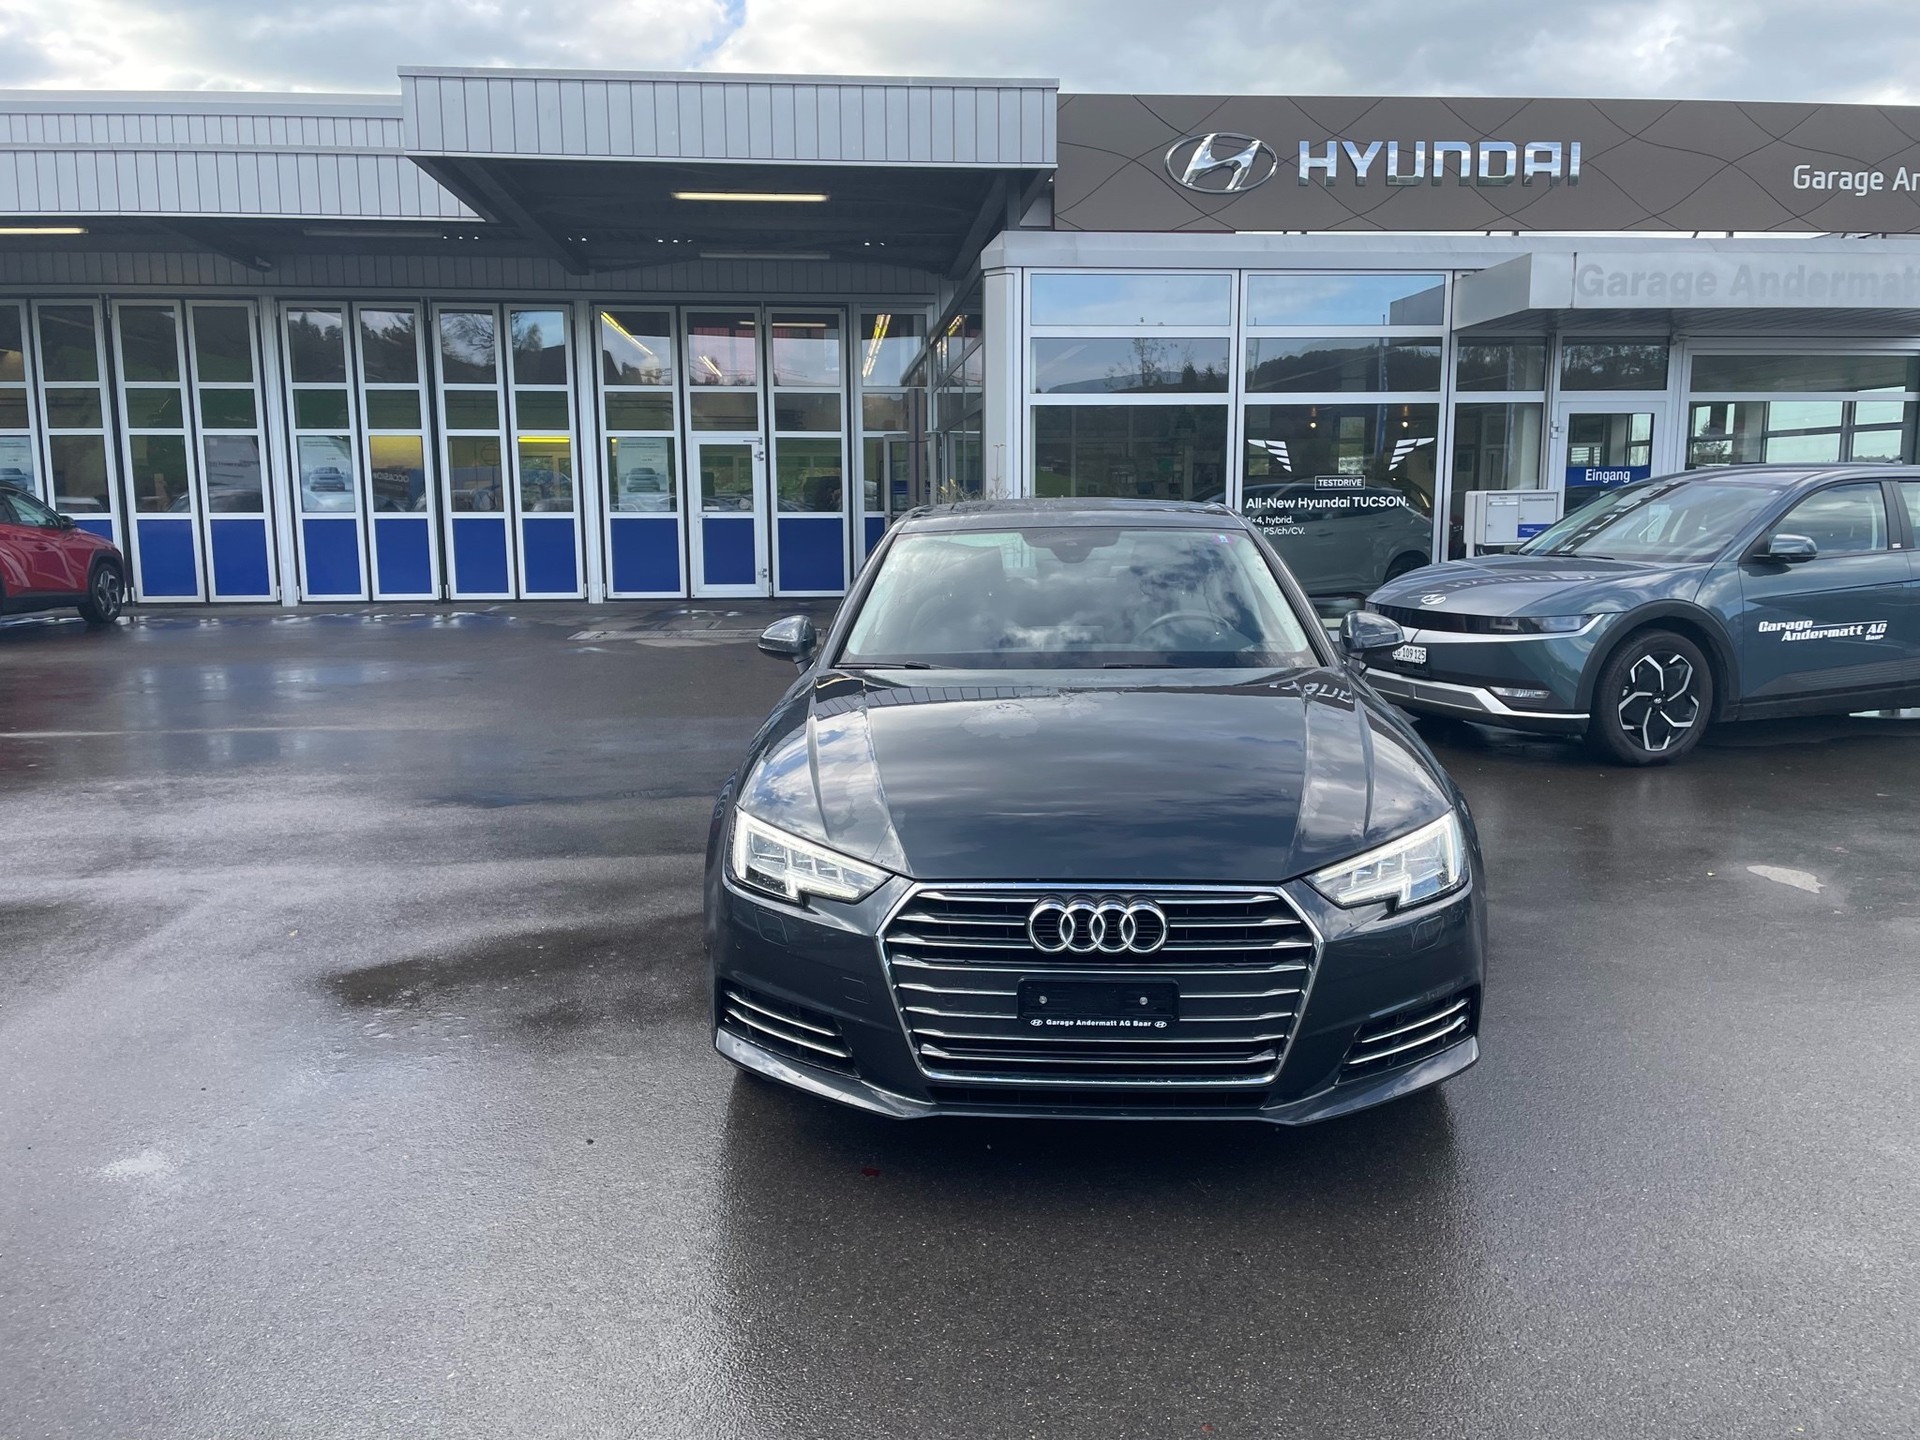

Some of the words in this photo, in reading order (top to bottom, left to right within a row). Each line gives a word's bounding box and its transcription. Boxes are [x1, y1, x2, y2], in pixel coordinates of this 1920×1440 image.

[1298, 141, 1582, 187] HYUNDAI
[1793, 164, 1884, 197] Garage
[1577, 264, 1717, 304] Garage
[1585, 468, 1631, 483] Eingang
[1317, 478, 1362, 487] TESTDRIVE
[1245, 497, 1295, 509] All-New
[1298, 496, 1350, 511] Hyundai
[1352, 495, 1409, 508] TUCSON.
[1265, 515, 1294, 526] hybrid.
[1263, 526, 1306, 535] PS/ch/CV.
[1758, 620, 1813, 632] Garage
[1781, 625, 1864, 641] Andermatt
[1866, 623, 1888, 634] AG
[1402, 647, 1414, 659] 109
[1046, 1019, 1074, 1027] Garage
[1076, 1019, 1117, 1027] Andermatt
